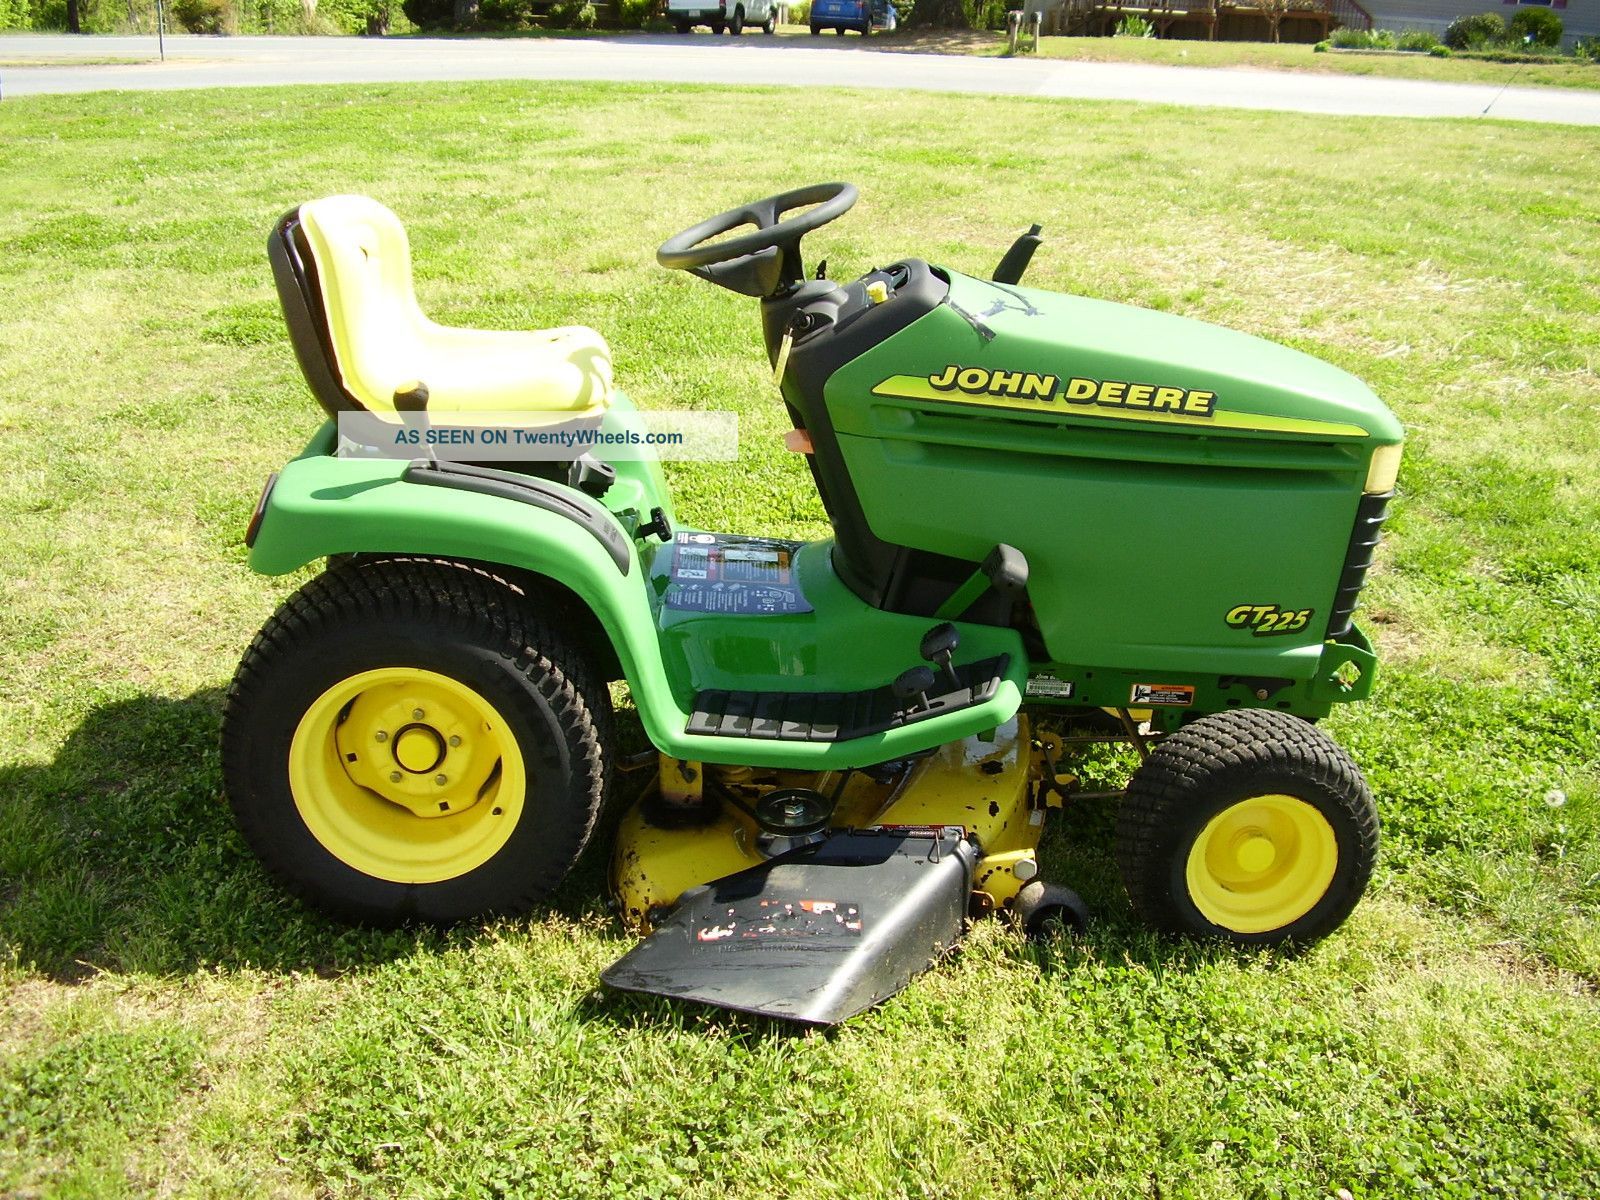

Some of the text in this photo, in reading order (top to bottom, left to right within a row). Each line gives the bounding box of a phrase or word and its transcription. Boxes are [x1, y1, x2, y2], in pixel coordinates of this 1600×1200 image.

[929, 365, 1216, 414] JOHN DEERE
[1225, 604, 1313, 635] GT225
